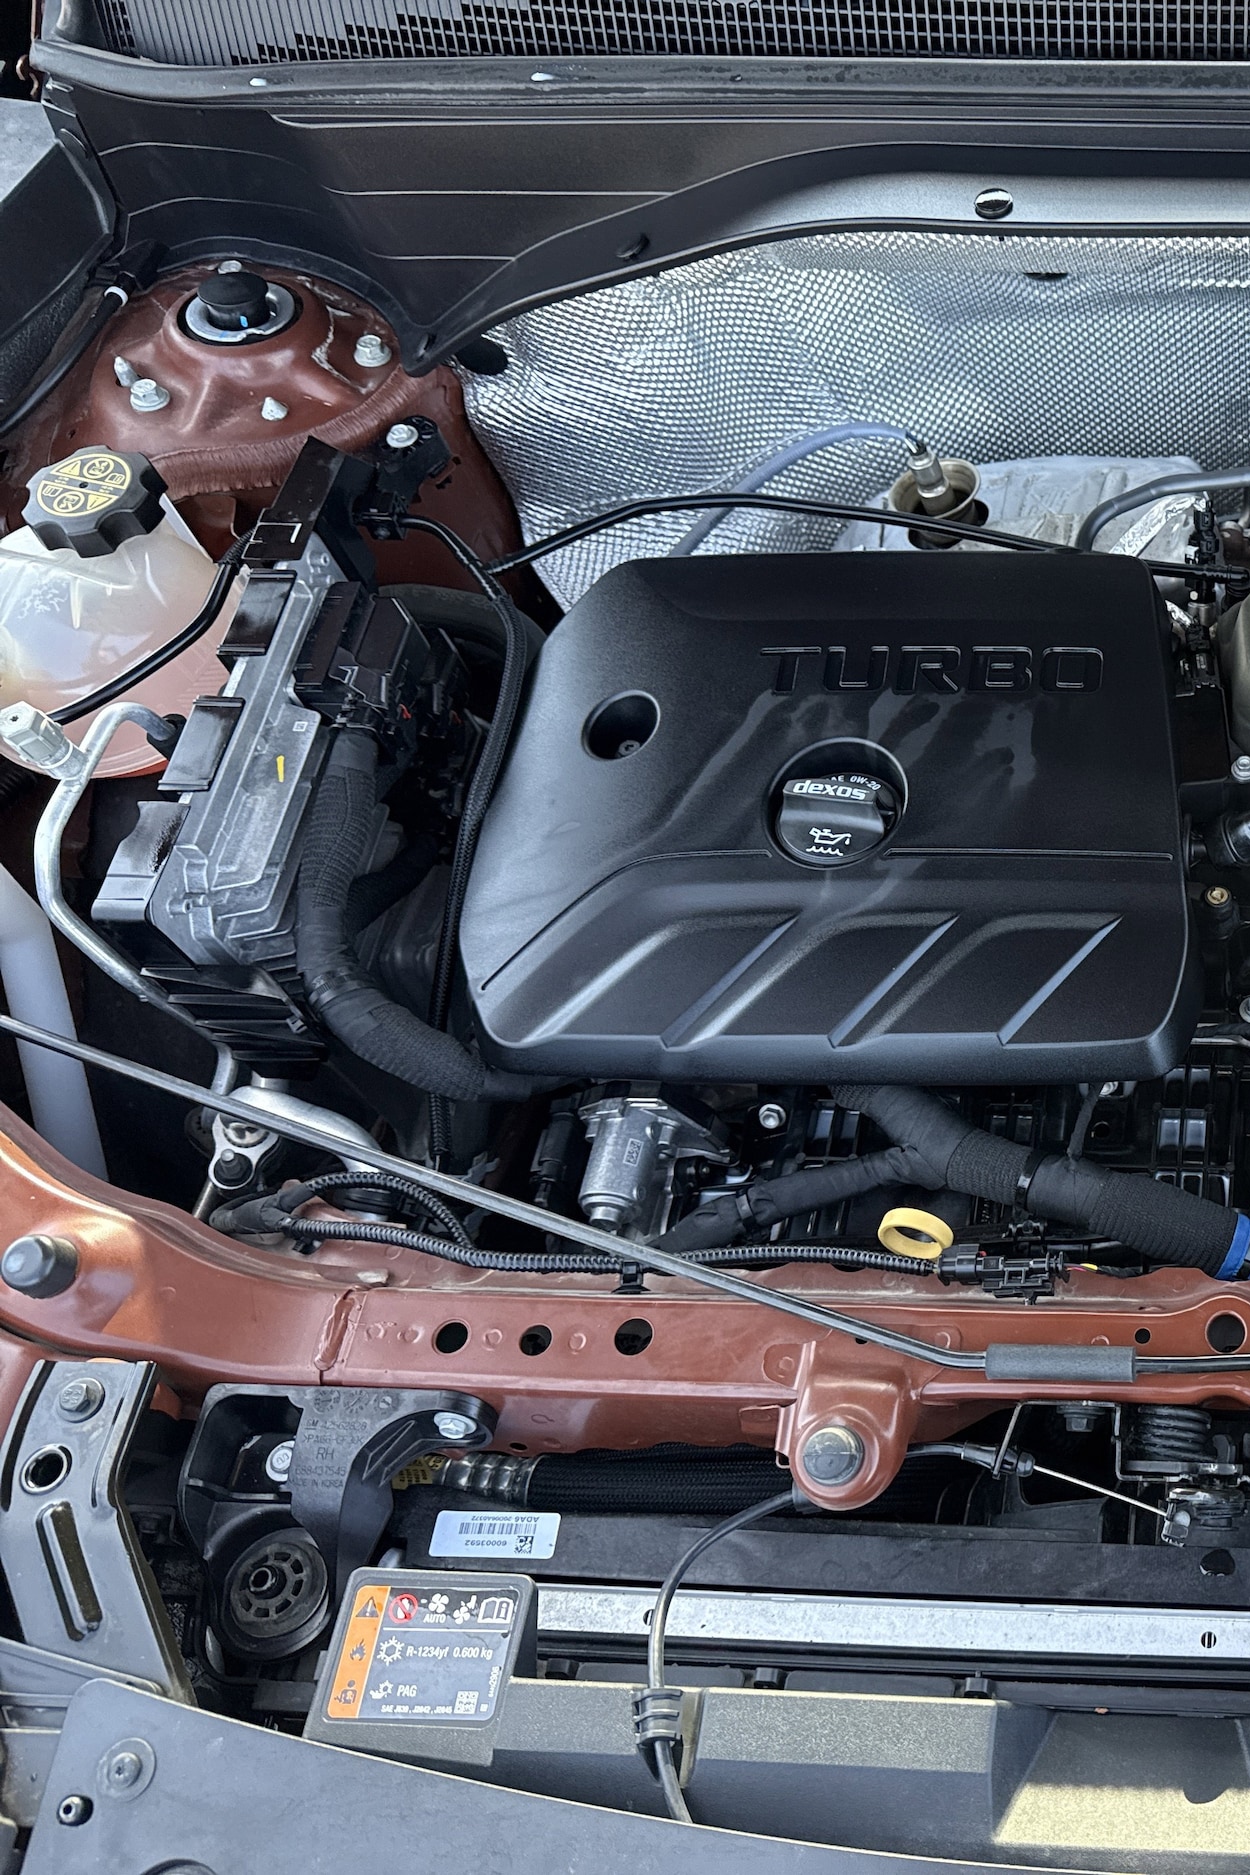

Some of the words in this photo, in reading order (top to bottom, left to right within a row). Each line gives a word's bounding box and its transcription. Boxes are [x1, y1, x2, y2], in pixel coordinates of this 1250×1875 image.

[759, 645, 1105, 695] TURBO
[793, 780, 867, 800] dexos
[850, 775, 881, 791] 0W-20
[315, 1446, 335, 1460] RH
[423, 1613, 446, 1623] AUTO
[406, 1646, 449, 1660] R-1234yf
[453, 1646, 479, 1658] 0.600
[481, 1647, 493, 1660] kg
[397, 1684, 417, 1697] PAG
[381, 1704, 394, 1713] SAE
